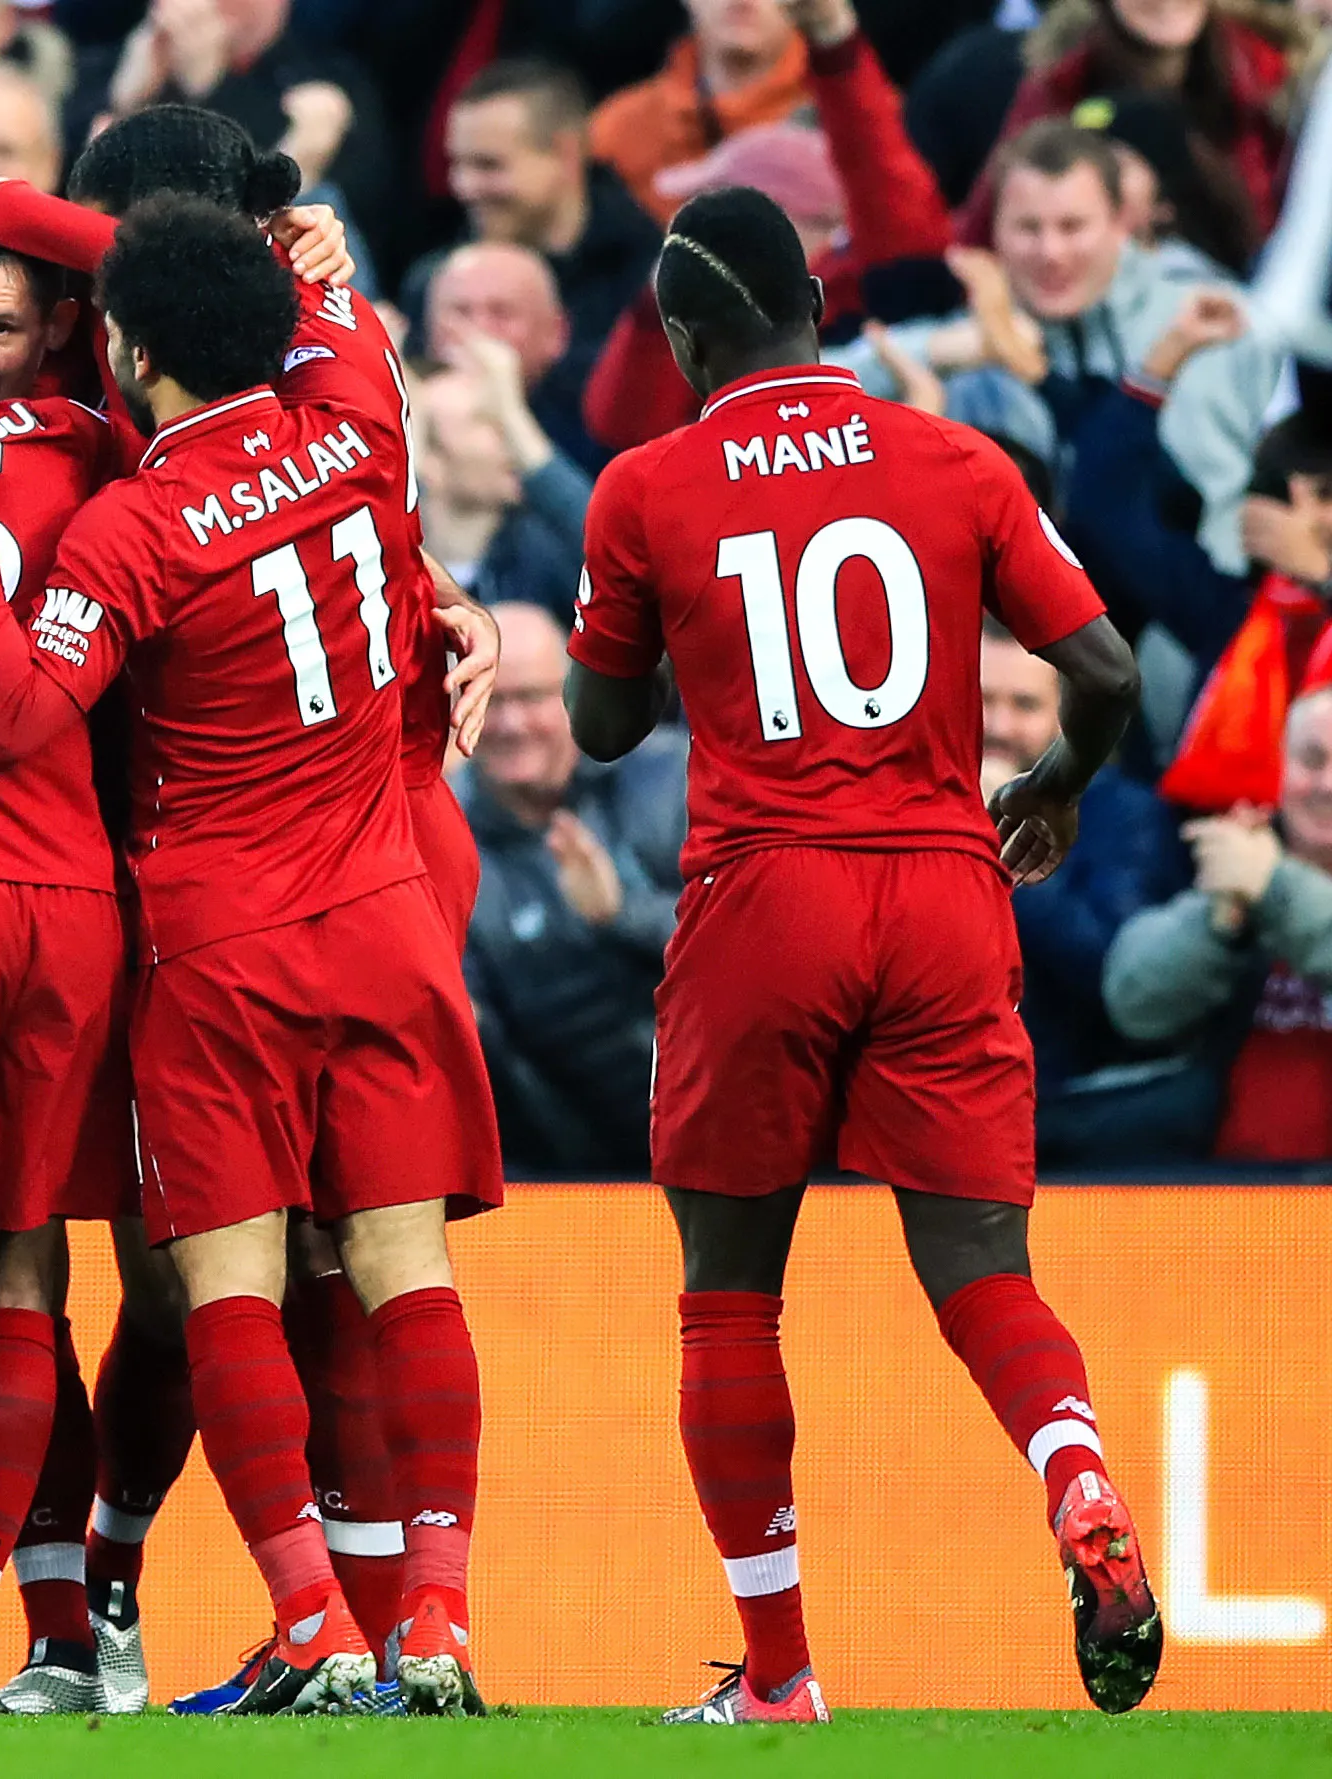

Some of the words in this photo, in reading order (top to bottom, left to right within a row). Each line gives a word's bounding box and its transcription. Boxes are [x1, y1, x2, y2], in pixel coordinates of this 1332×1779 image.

[181, 420, 372, 546] M.SALAH
[721, 413, 875, 481] MANÉ
[36, 633, 86, 667] Union
[250, 505, 398, 728] 11
[716, 515, 931, 742] 10
